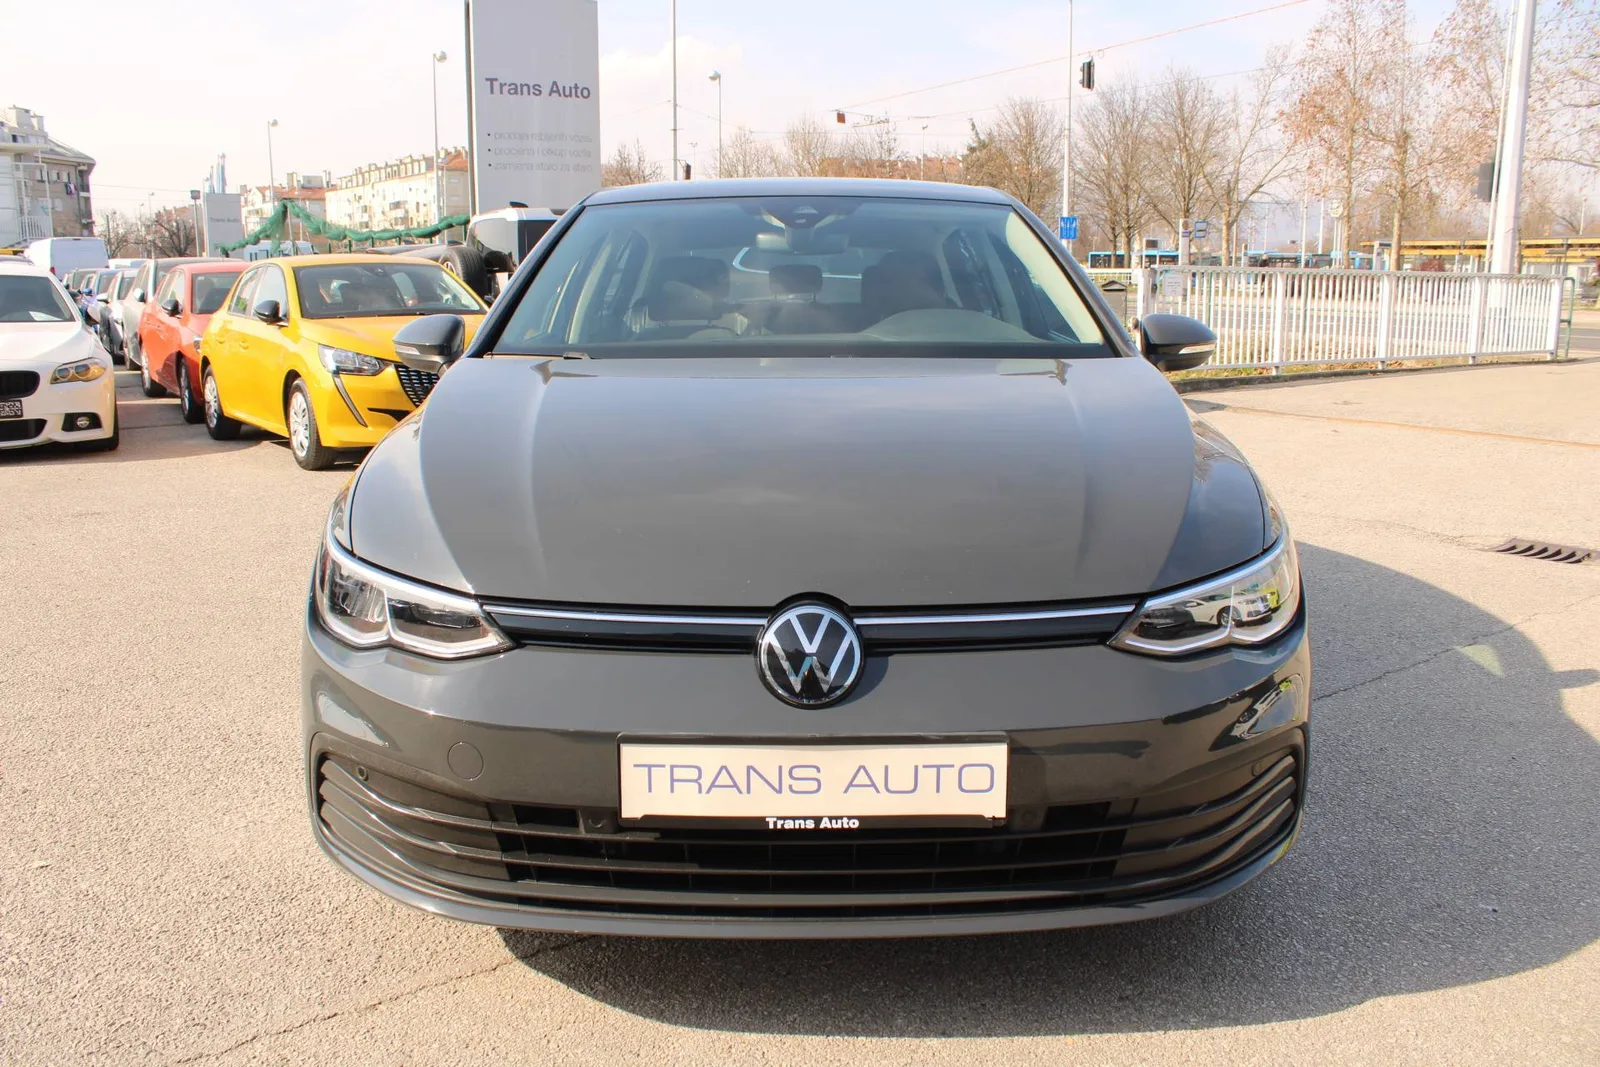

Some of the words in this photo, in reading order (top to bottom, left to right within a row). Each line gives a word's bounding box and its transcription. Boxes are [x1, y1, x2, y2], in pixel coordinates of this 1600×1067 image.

[485, 77, 542, 96] Trans
[548, 80, 591, 99] Auto
[633, 763, 822, 795] TRANS
[843, 763, 995, 795] AUTO
[765, 816, 815, 829] Trans
[818, 816, 860, 829] Auto
